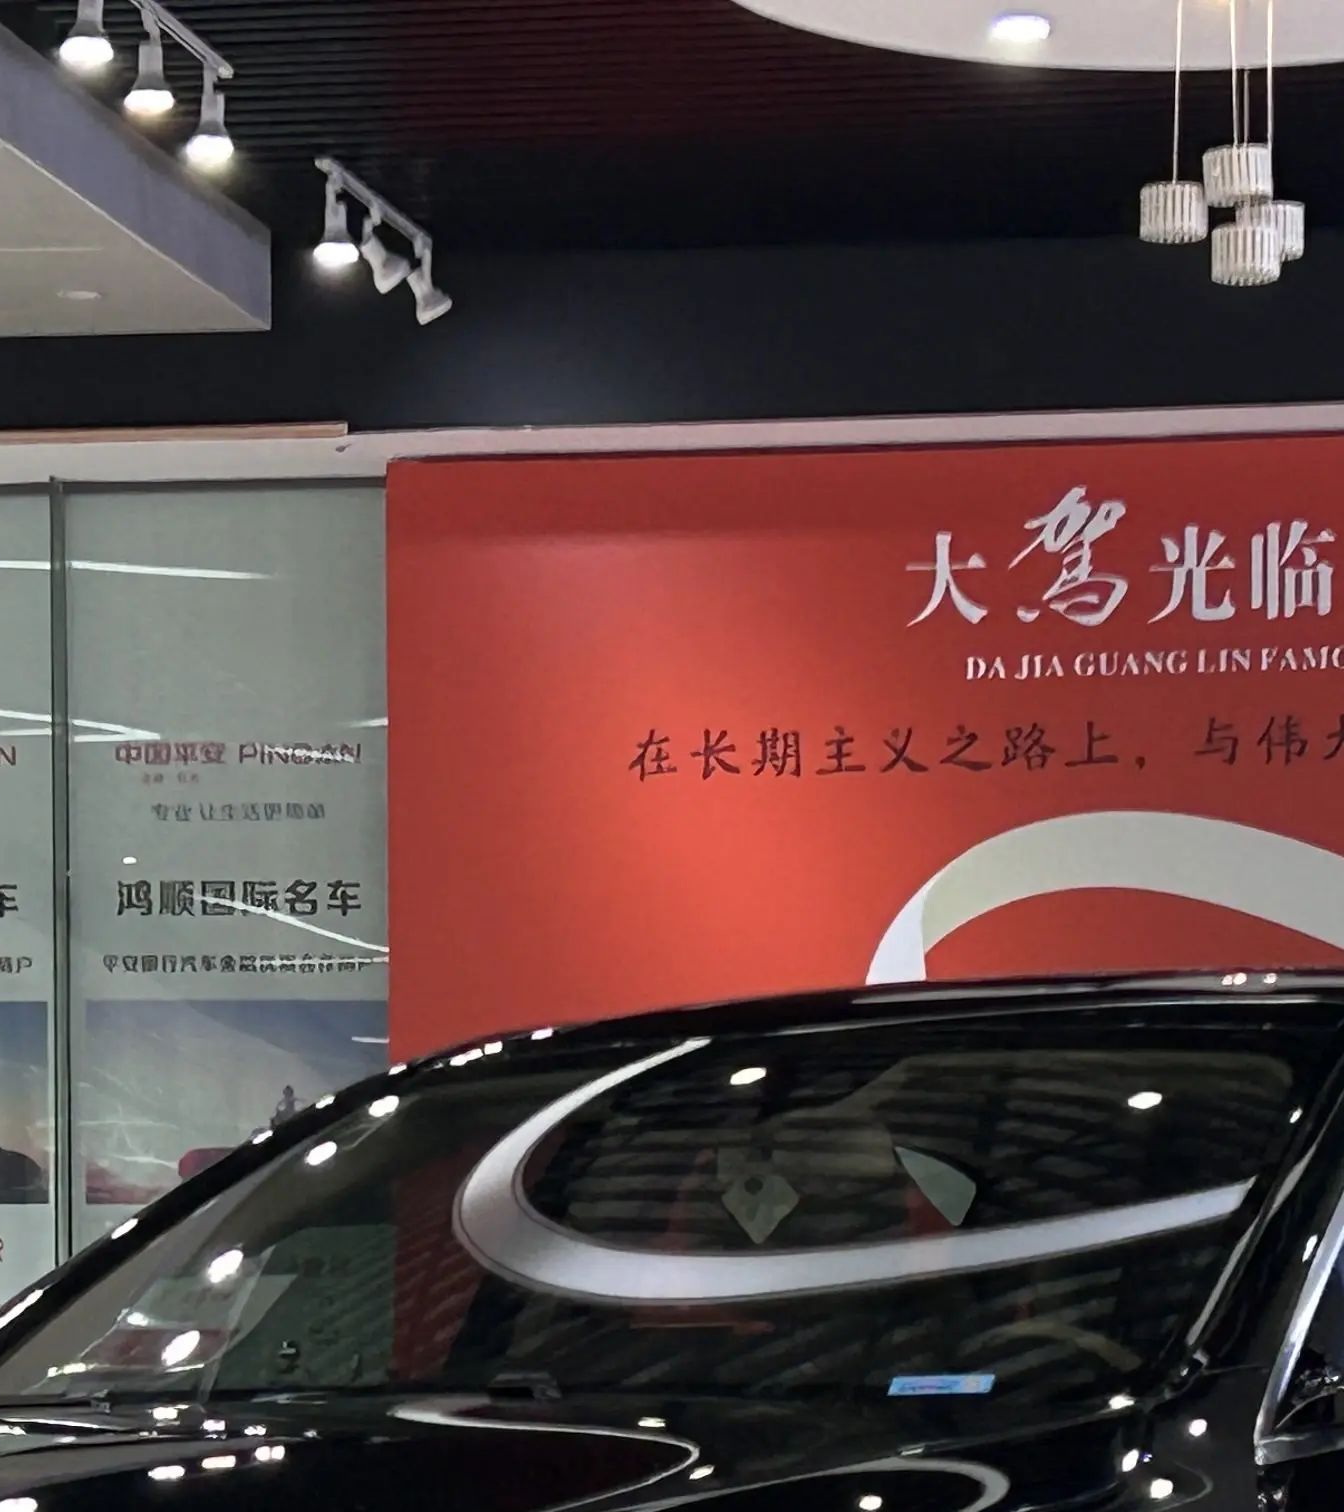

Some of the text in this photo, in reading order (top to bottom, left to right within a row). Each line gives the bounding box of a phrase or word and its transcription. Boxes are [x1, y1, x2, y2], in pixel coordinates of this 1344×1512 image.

[965, 655, 1006, 681] DA
[1014, 653, 1065, 681] JIA
[1073, 649, 1189, 677] GUANG
[1197, 647, 1252, 673] LIN
[116, 878, 362, 917] 鸿顺国际名车
